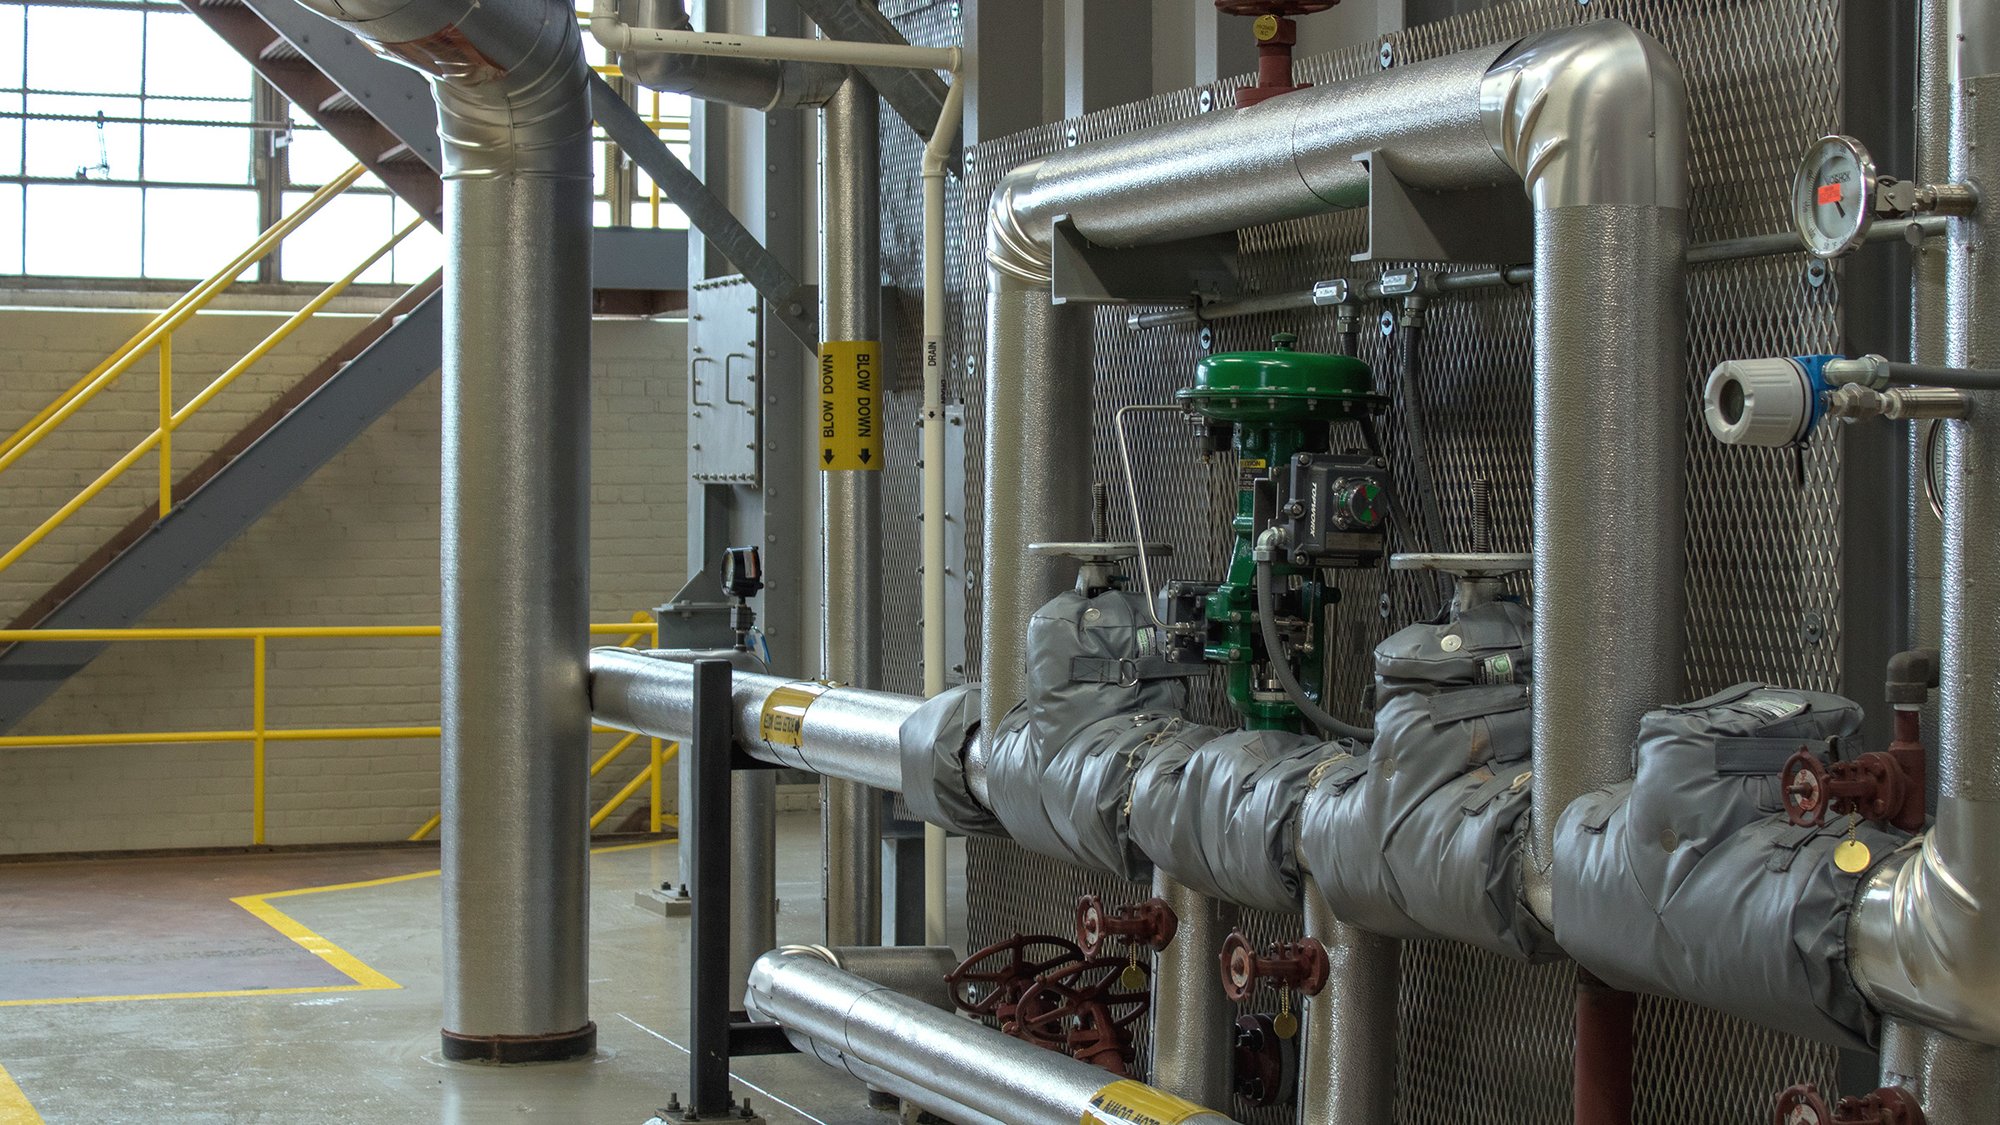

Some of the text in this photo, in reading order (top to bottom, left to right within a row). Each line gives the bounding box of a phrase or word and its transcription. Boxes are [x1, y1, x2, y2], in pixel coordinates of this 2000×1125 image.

[928, 341, 937, 366] DRAIN
[822, 354, 834, 438] BLOW DOWN
[856, 354, 871, 437] BLOW DOWN
[1103, 1099, 1134, 1120] DOWN
